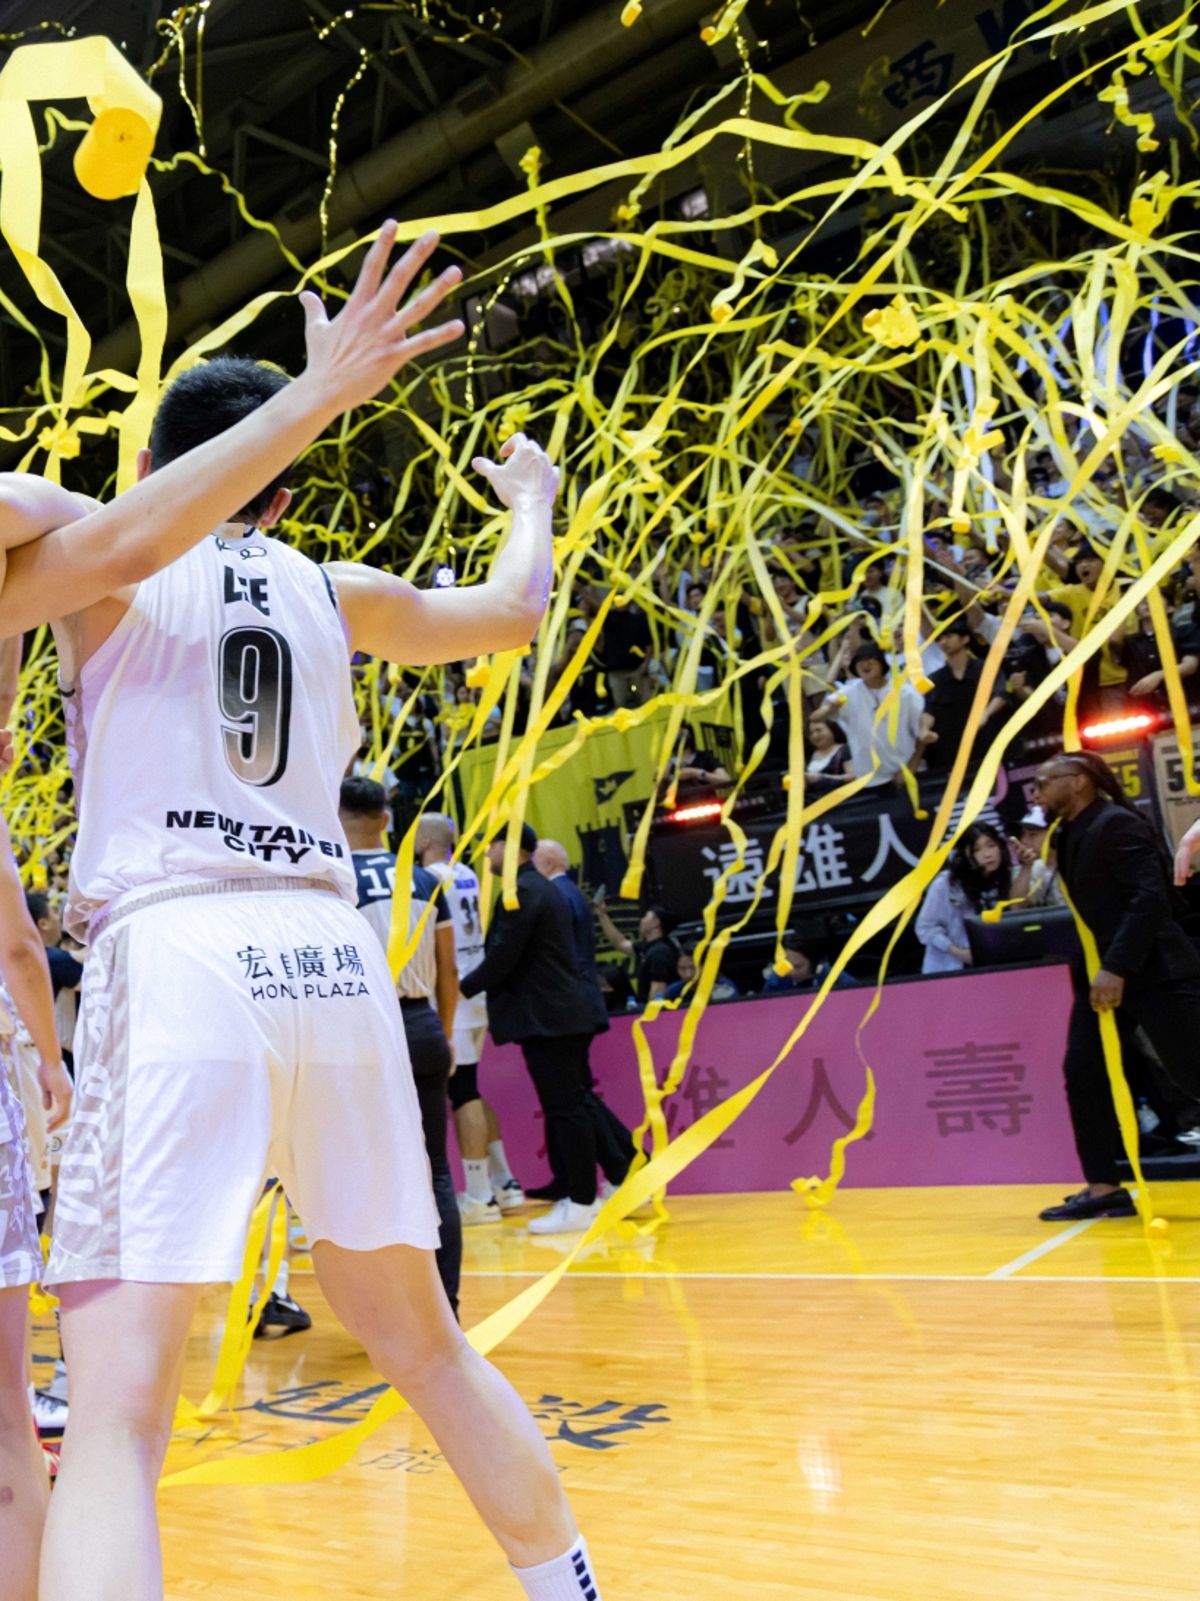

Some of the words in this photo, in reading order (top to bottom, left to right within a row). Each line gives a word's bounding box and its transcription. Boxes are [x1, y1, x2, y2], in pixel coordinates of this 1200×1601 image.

[218, 625, 292, 787] 9
[166, 811, 244, 836] NEW
[249, 825, 343, 858] TAIEI
[224, 835, 311, 864] CITY
[304, 982, 369, 998] PLAZA
[535, 1041, 1034, 1162] 雄人壽
